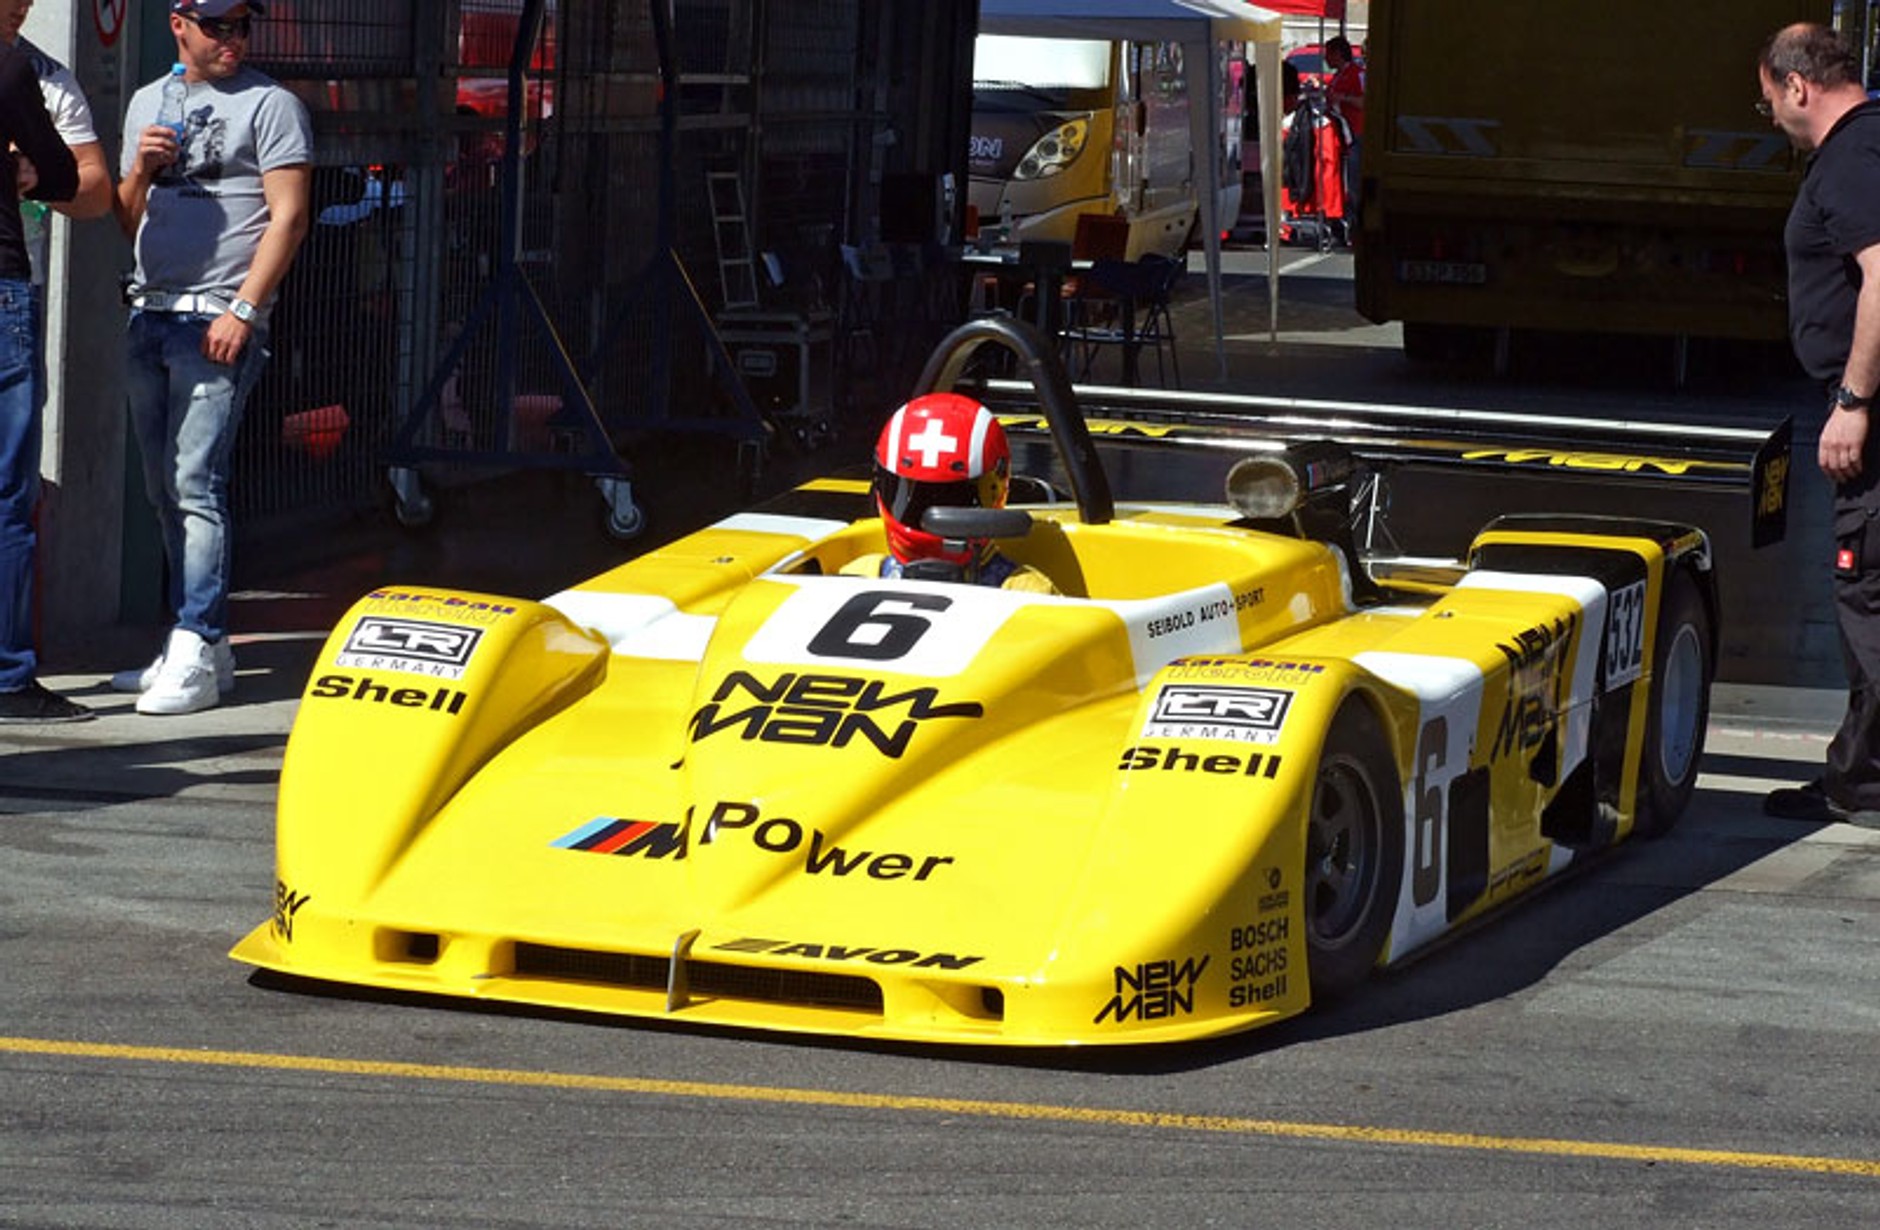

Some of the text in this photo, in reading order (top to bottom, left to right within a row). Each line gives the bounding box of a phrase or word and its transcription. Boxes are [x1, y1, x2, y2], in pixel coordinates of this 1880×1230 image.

[806, 590, 953, 661] 6
[1147, 611, 1195, 639] SEIBOLD
[1607, 583, 1645, 675] 532
[311, 675, 468, 716] Shell
[1118, 747, 1282, 779] Shell
[1411, 715, 1447, 908] 6
[699, 801, 954, 881] Power
[1231, 917, 1289, 951] BOSCH
[771, 943, 986, 970] AVON
[1230, 948, 1287, 982] SACHS
[1229, 977, 1287, 1008] Shell
